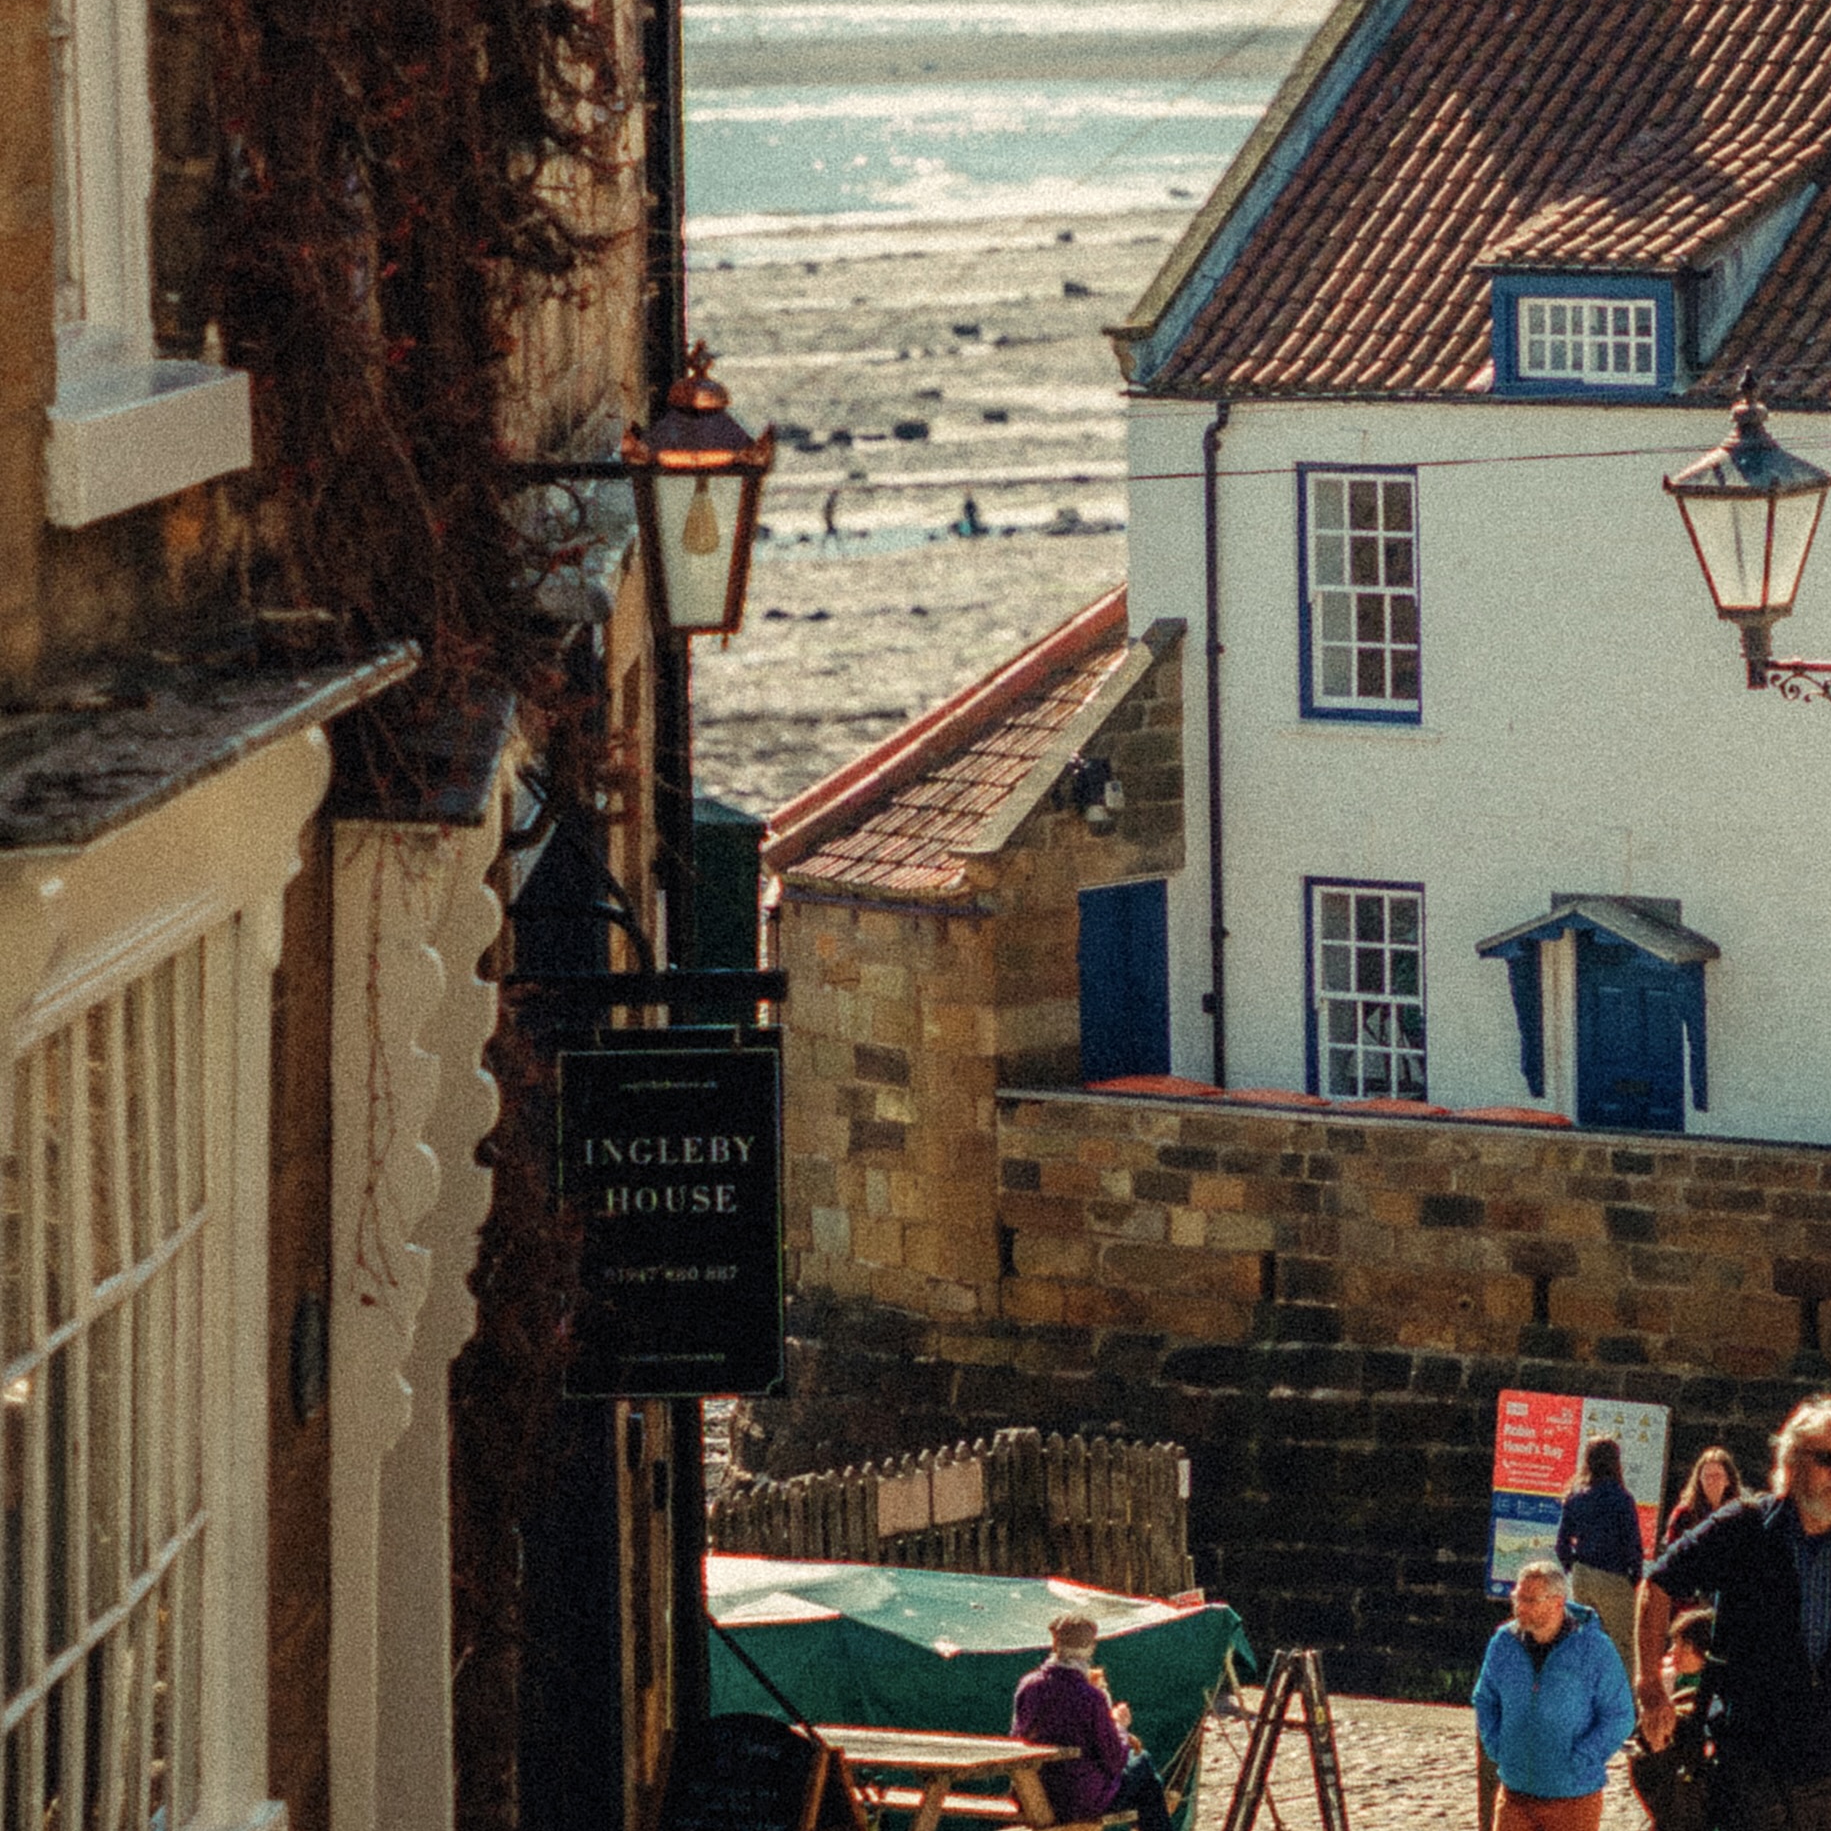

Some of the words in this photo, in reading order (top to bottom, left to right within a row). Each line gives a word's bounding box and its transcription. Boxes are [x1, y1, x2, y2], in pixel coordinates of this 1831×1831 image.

[584, 1135, 756, 1166] INGLEBY
[605, 1184, 739, 1214] HOUSE
[1503, 1423, 1536, 1438] Robin
[1503, 1440, 1540, 1455] Hood's
[1542, 1444, 1564, 1460] Bay
